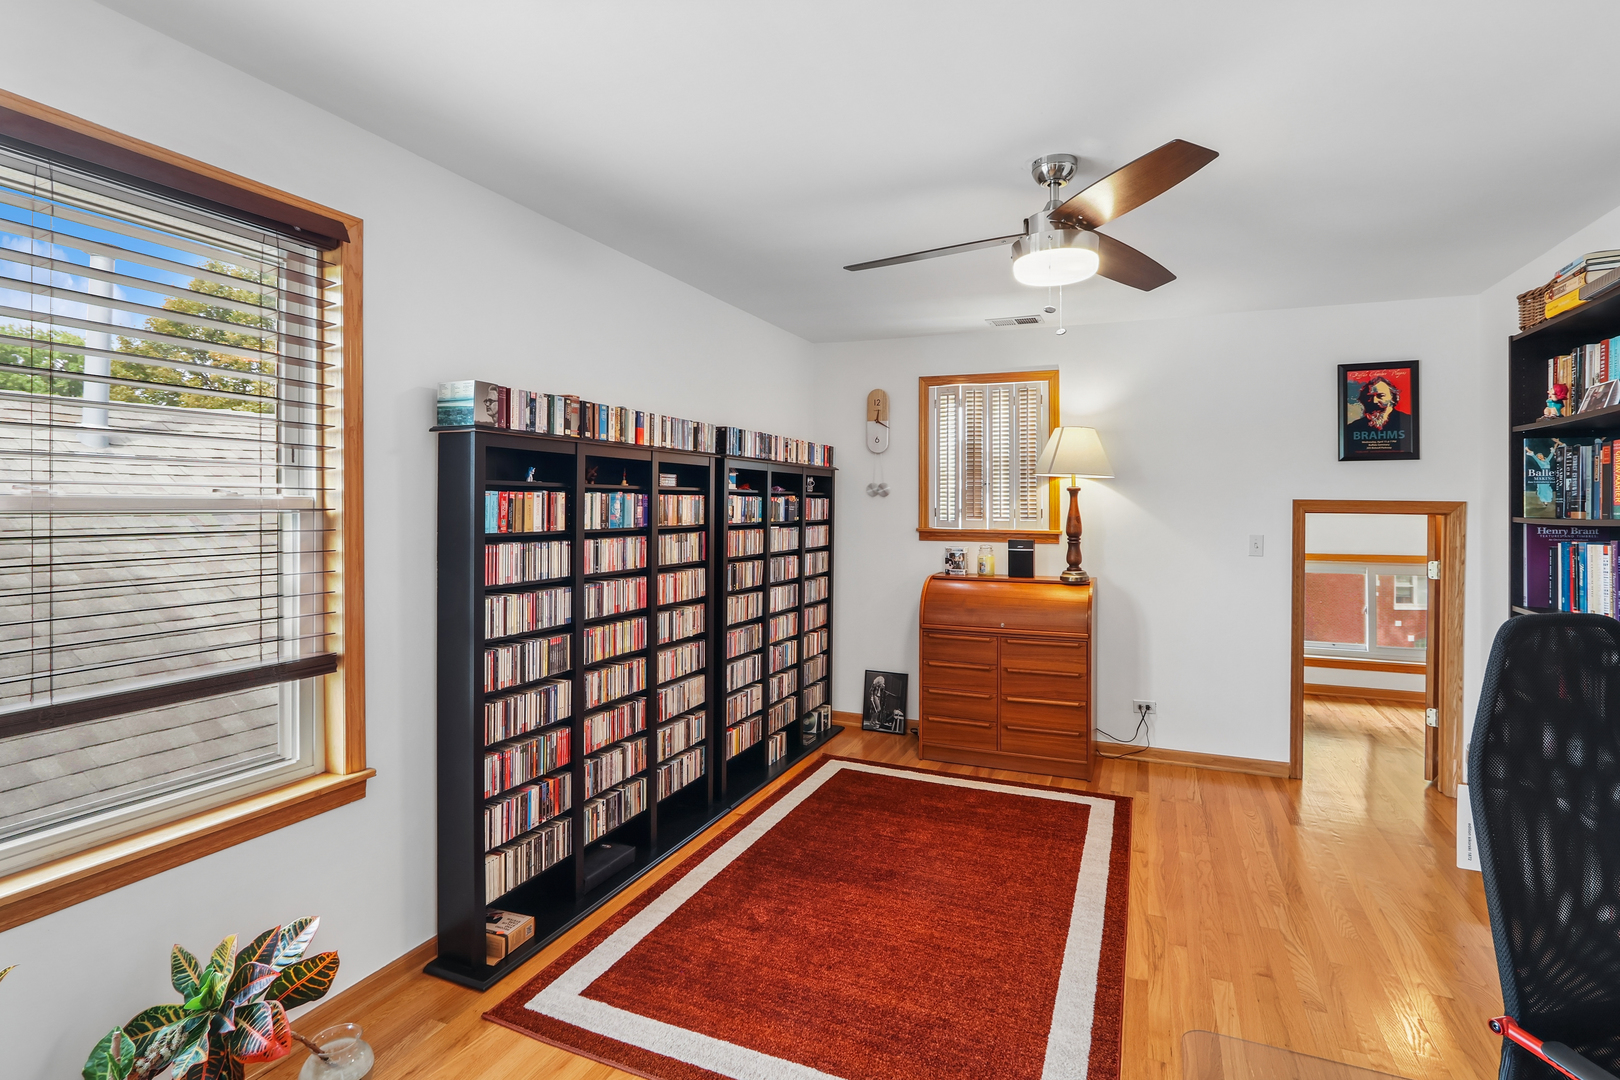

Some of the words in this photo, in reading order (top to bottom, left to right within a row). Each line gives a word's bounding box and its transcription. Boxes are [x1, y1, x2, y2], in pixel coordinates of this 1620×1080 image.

[873, 398, 881, 407] 12
[1353, 430, 1405, 440] BRAHMS
[874, 436, 880, 444] 6
[1528, 469, 1556, 477] Balle
[1537, 527, 1568, 537] Henry
[1570, 527, 1599, 535] Brant
